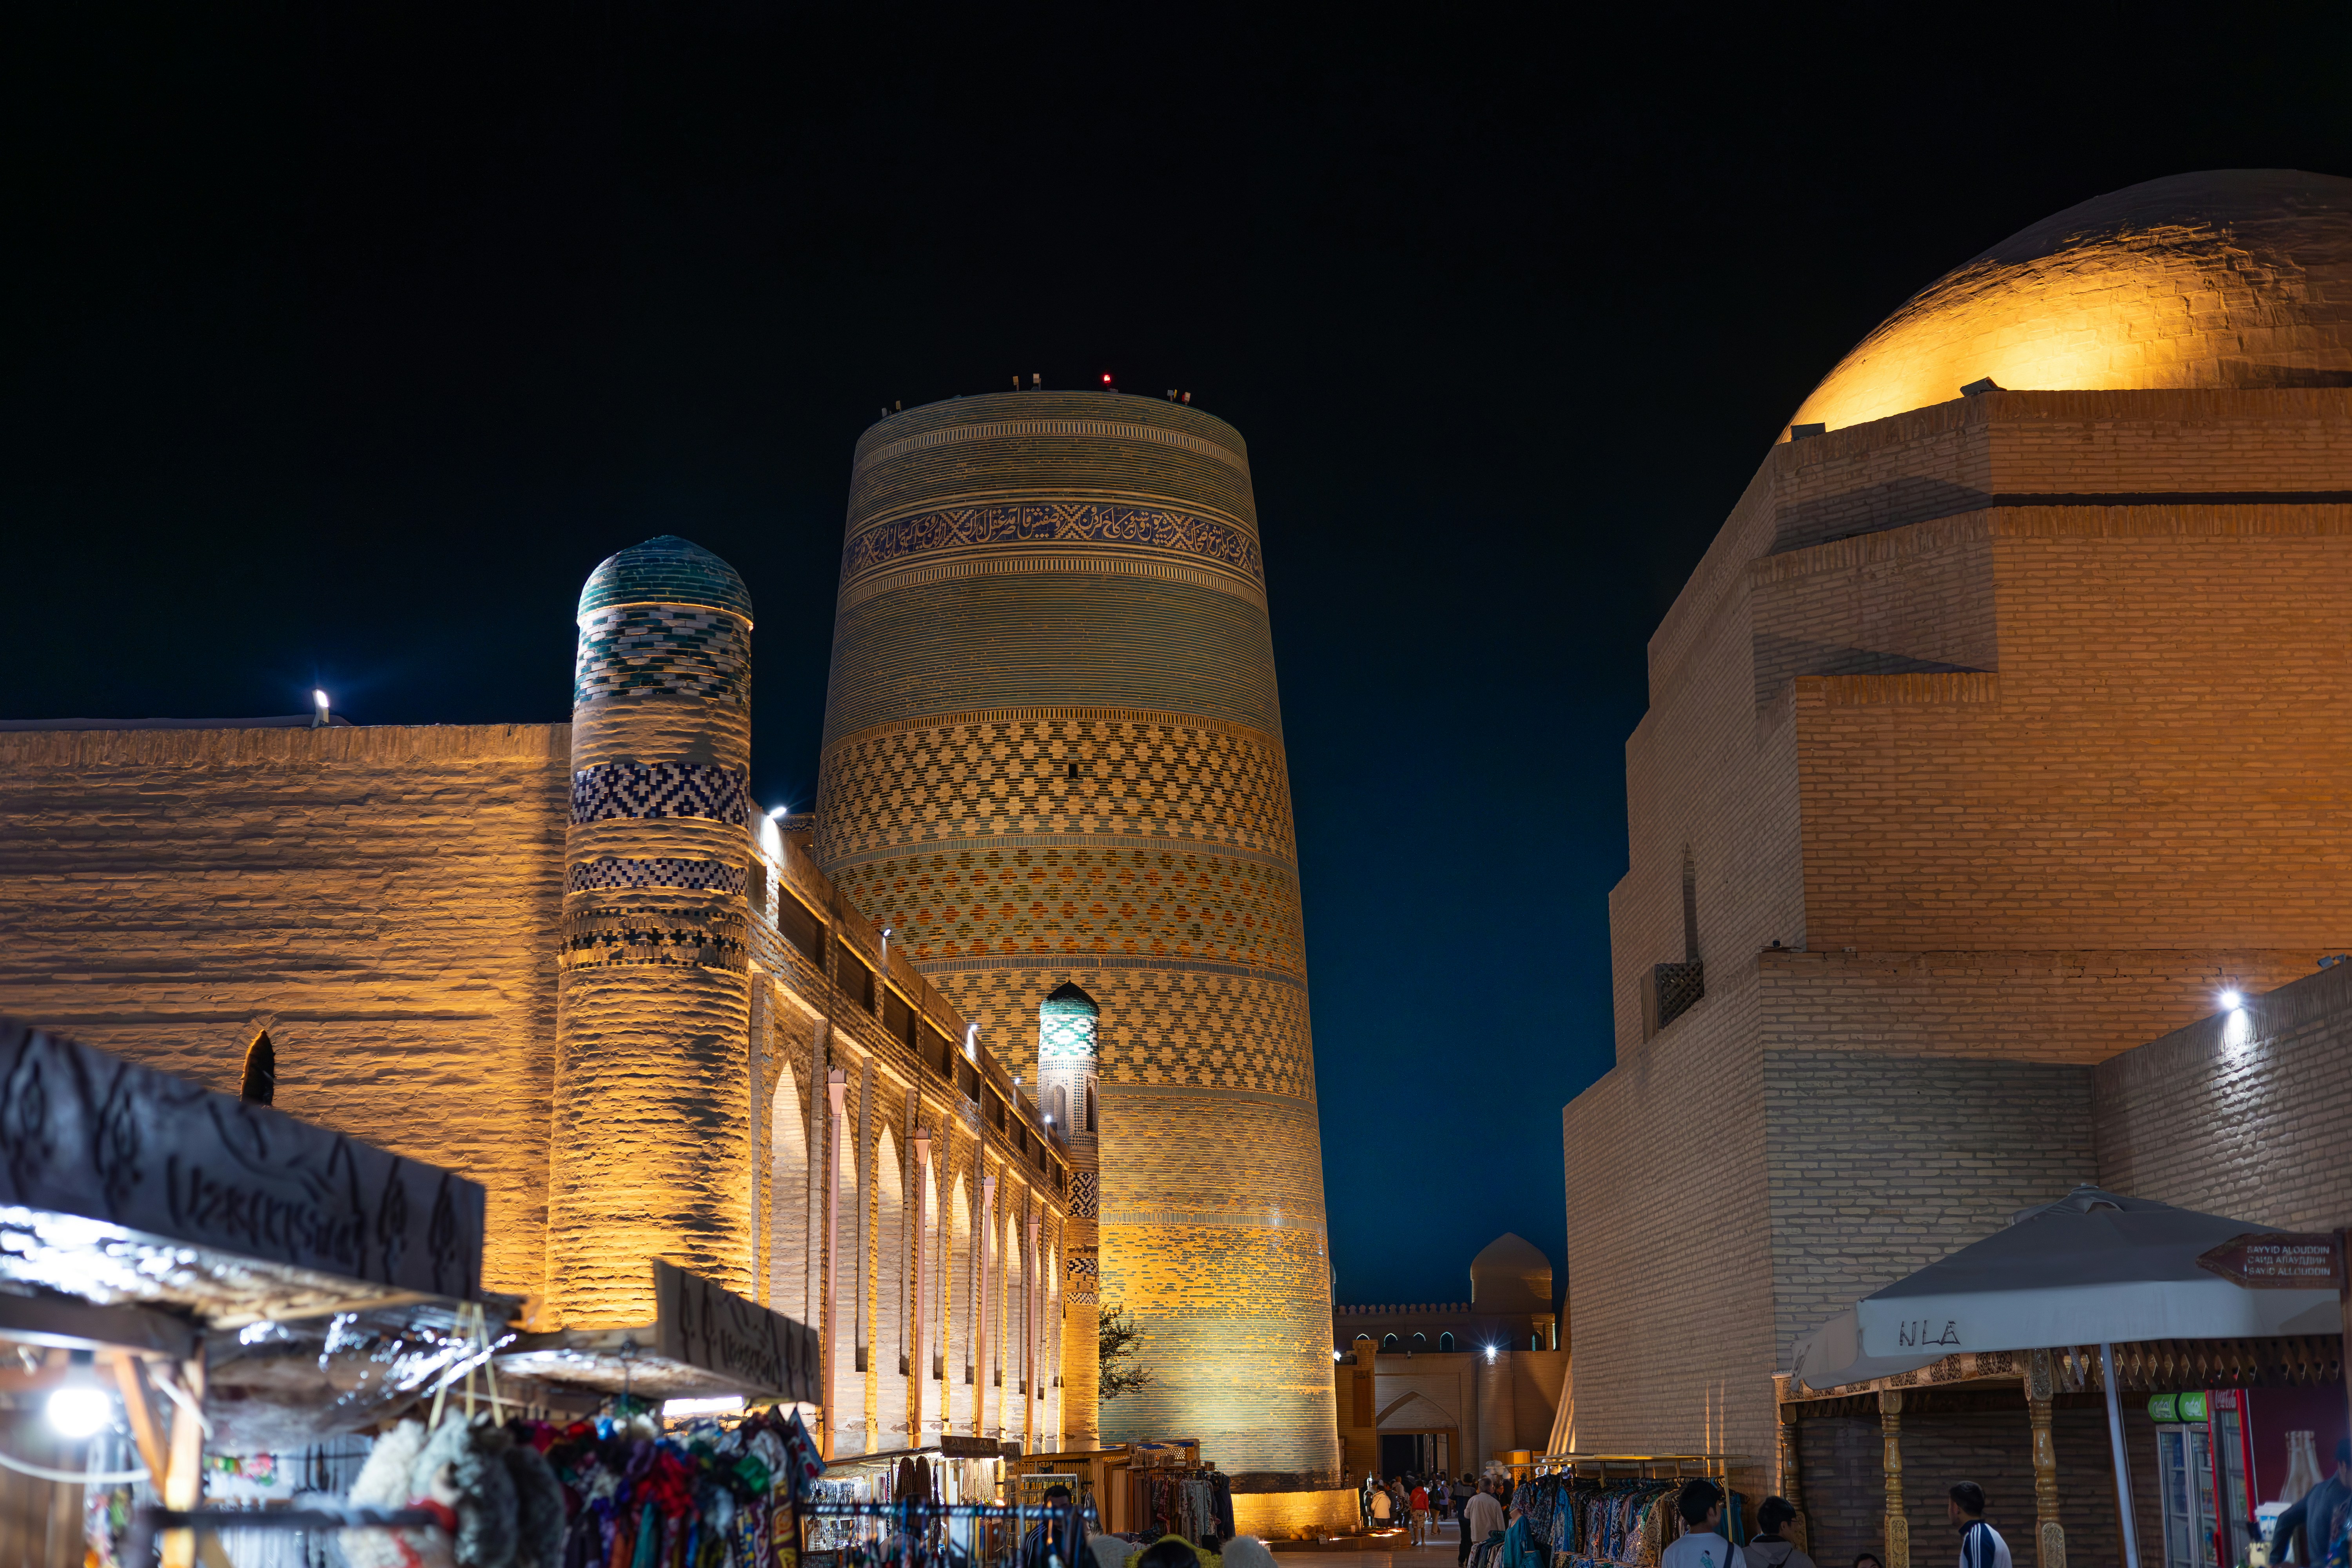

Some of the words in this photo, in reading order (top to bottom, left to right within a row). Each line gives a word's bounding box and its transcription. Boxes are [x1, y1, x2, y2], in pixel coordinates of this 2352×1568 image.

[2247, 1246, 2280, 1254] SAYYID
[2282, 1246, 2330, 1254] ALOUDDIN
[2249, 1267, 2275, 1275] SAYID
